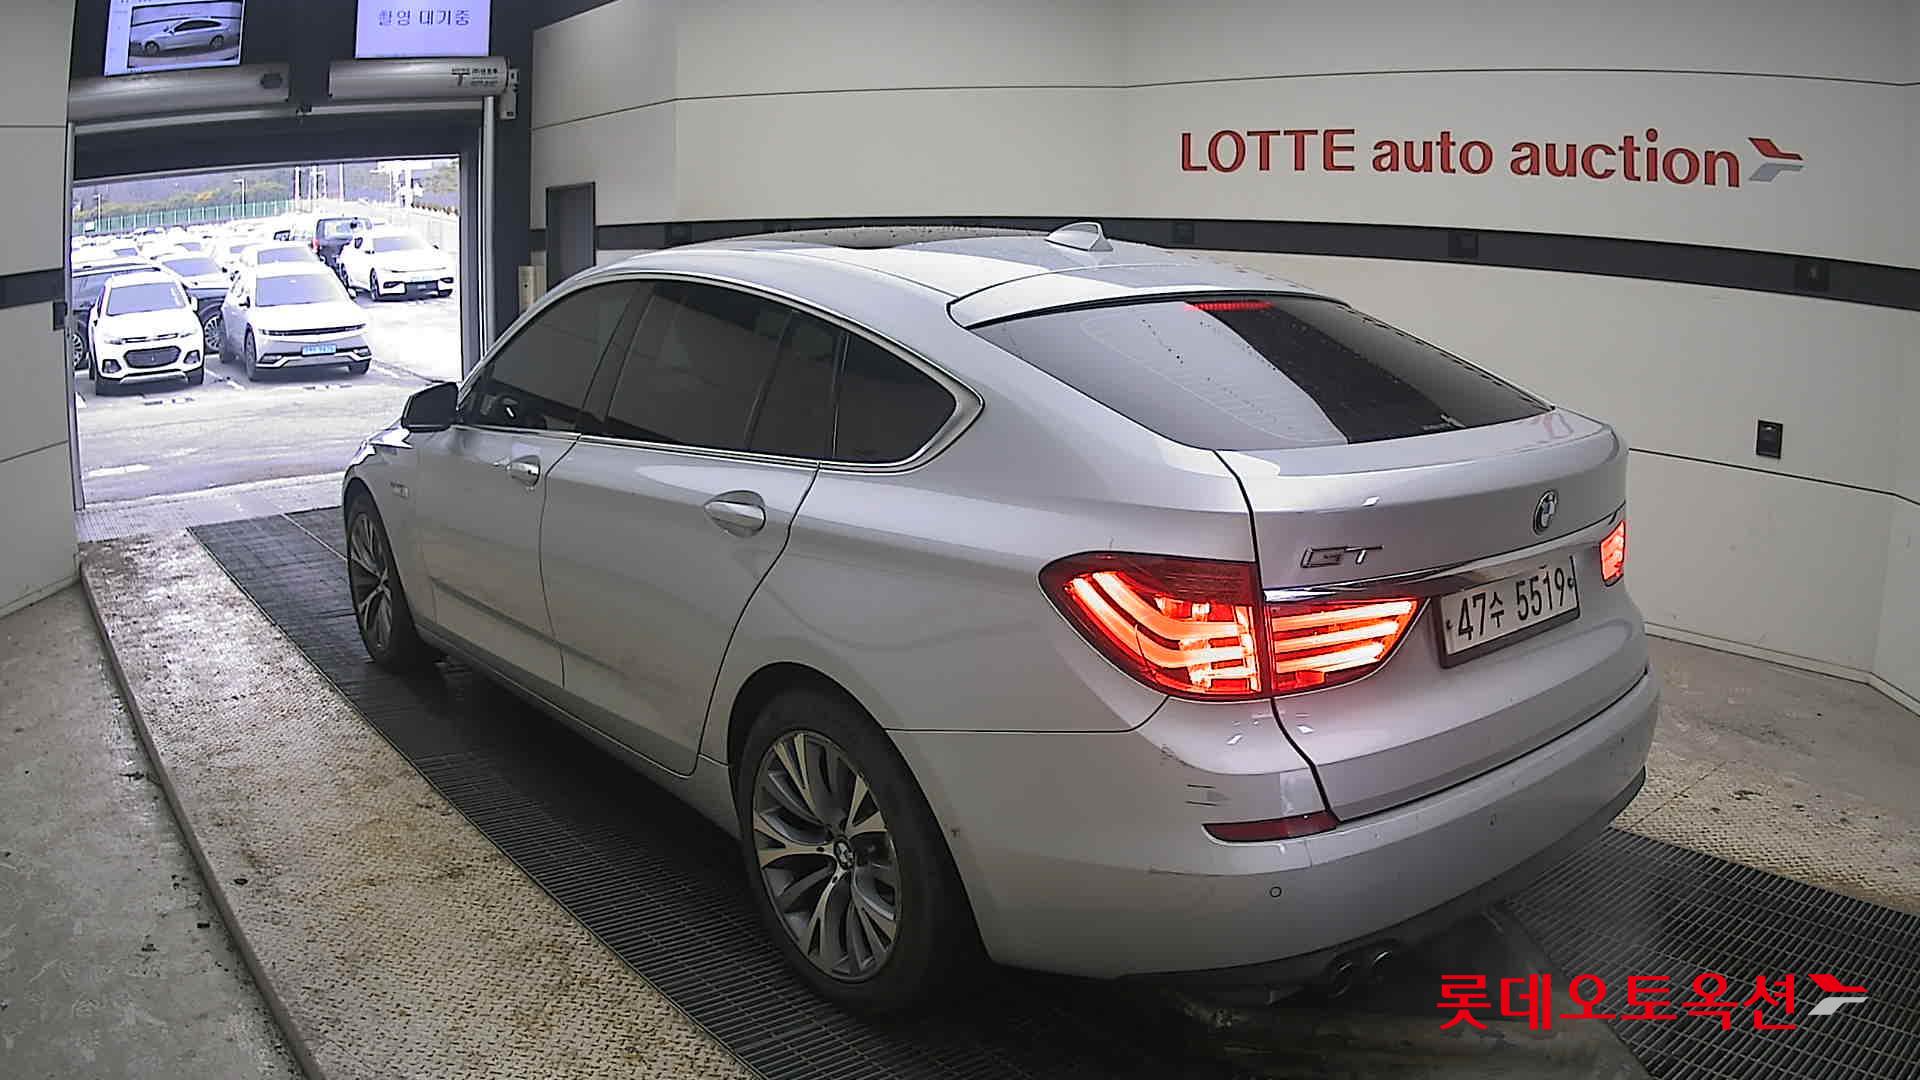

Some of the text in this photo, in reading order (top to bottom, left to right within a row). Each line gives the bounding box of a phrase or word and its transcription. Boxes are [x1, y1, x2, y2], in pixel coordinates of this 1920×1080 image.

[418, 9, 471, 26] 대기중
[1181, 127, 1740, 189] LOTTE auto auction
[1300, 545, 1384, 568] GT
[1457, 567, 1565, 641] 47수 5519
